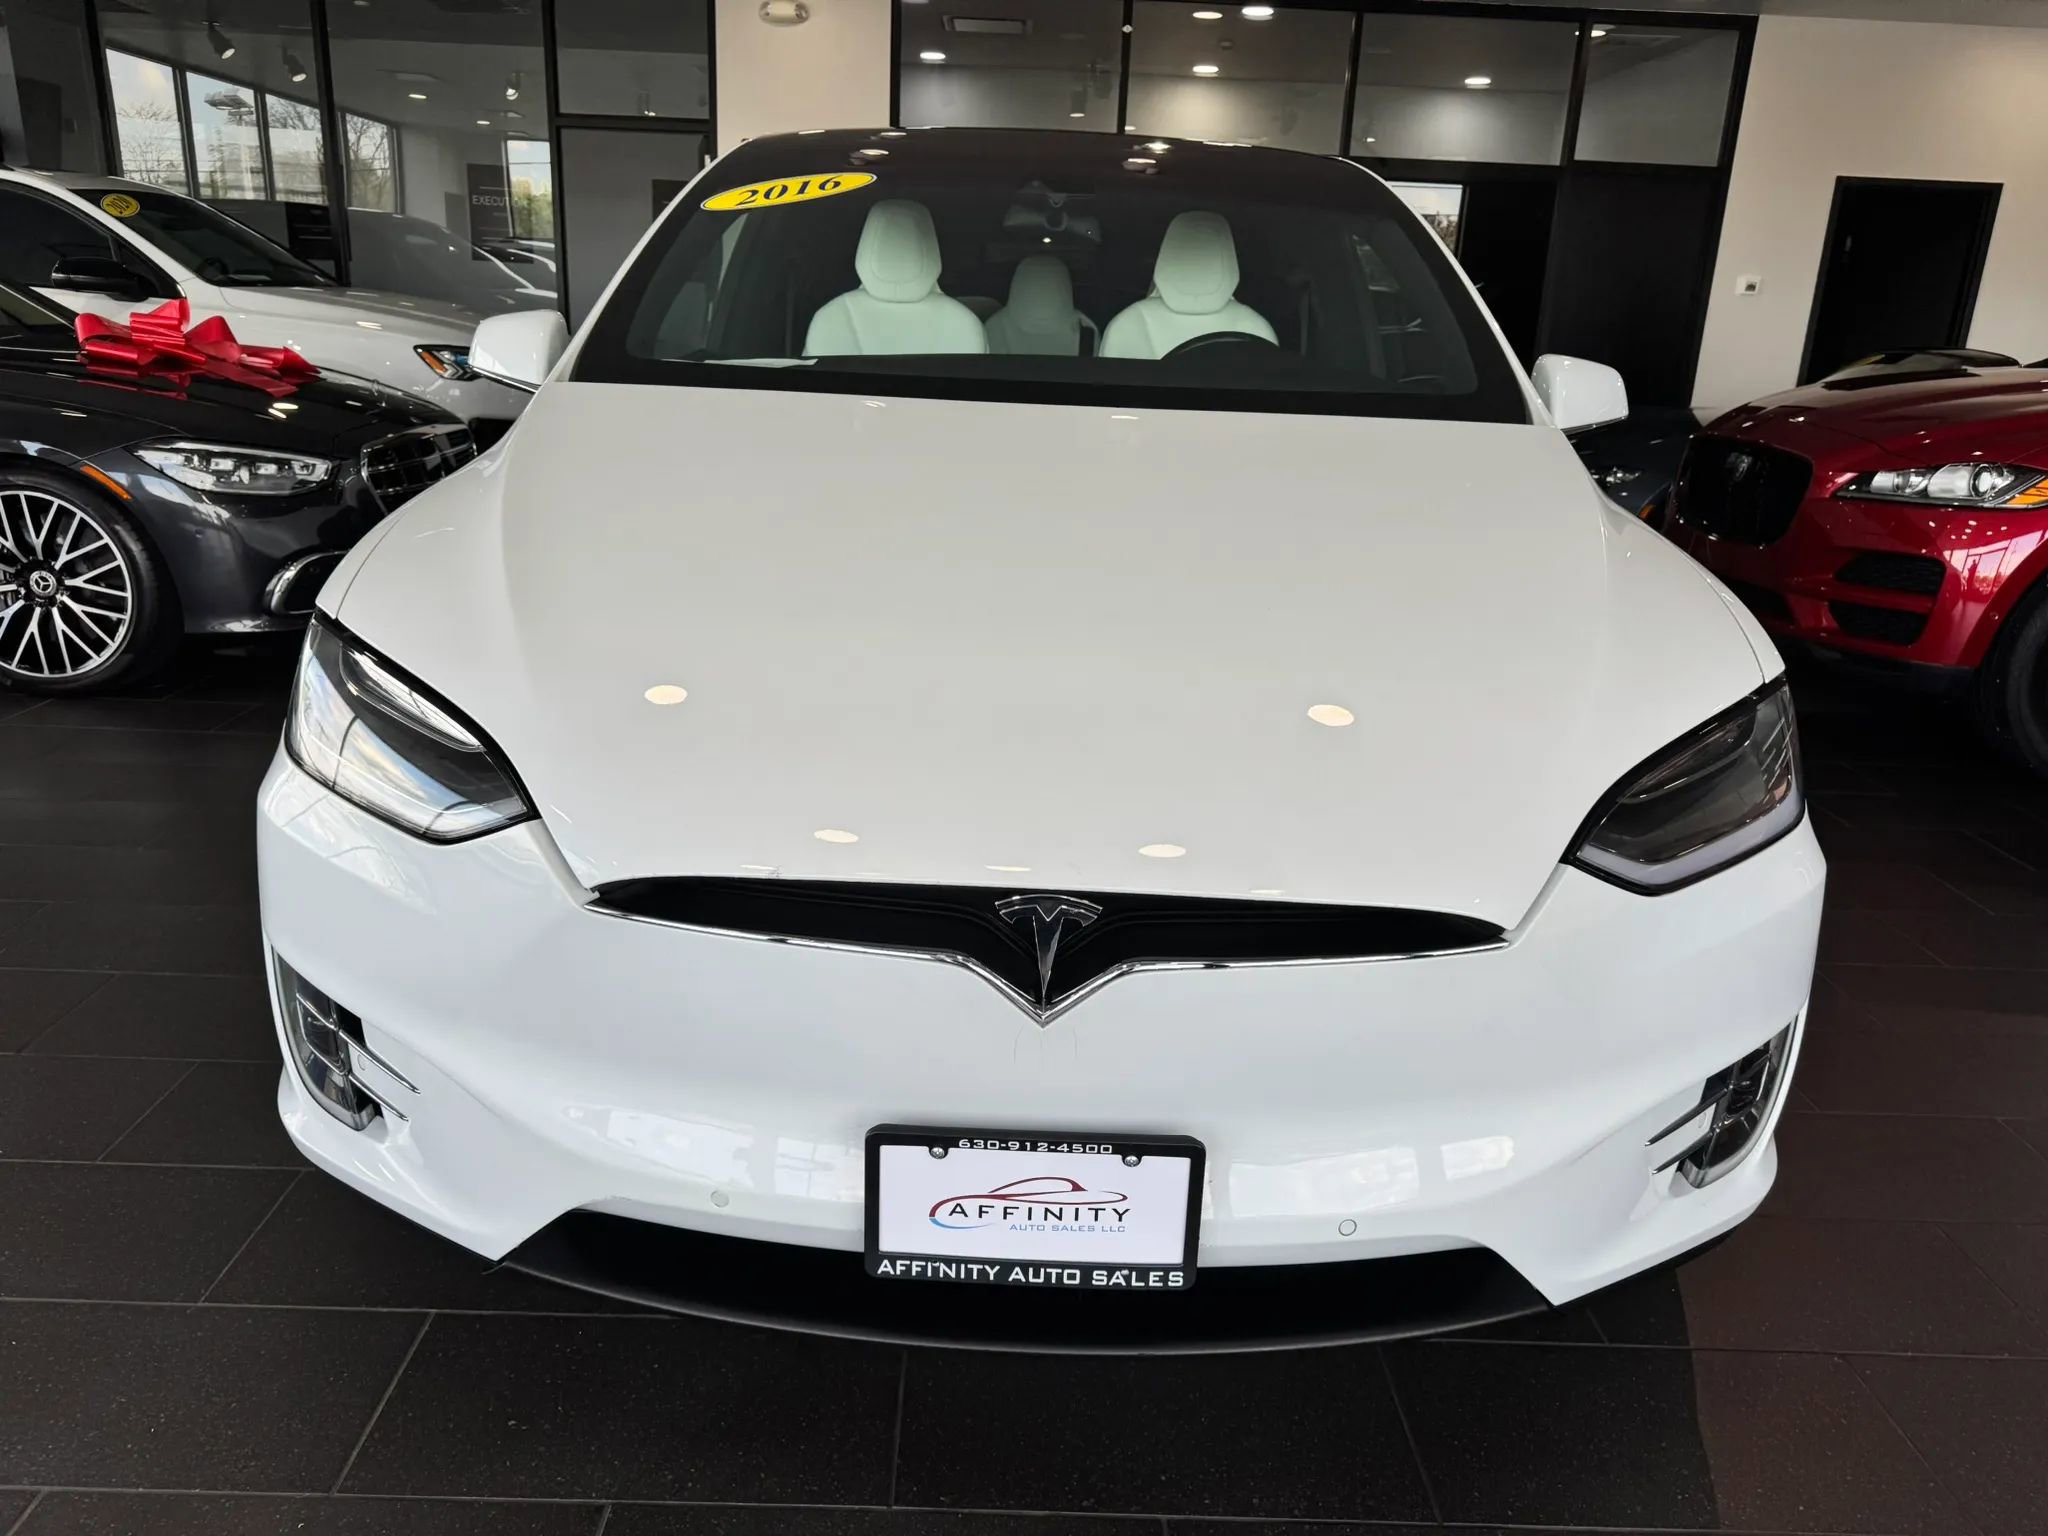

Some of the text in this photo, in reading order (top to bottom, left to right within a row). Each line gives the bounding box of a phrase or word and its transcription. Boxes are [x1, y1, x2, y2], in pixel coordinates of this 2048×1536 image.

[735, 174, 844, 207] 2016
[958, 1138, 1113, 1155] 630-912-4500
[948, 1202, 1131, 1223] AFFINITY
[1008, 1223, 1126, 1233] AUTO SALES LLC
[876, 1258, 1185, 1288] AFFINITY AUTO SALES
